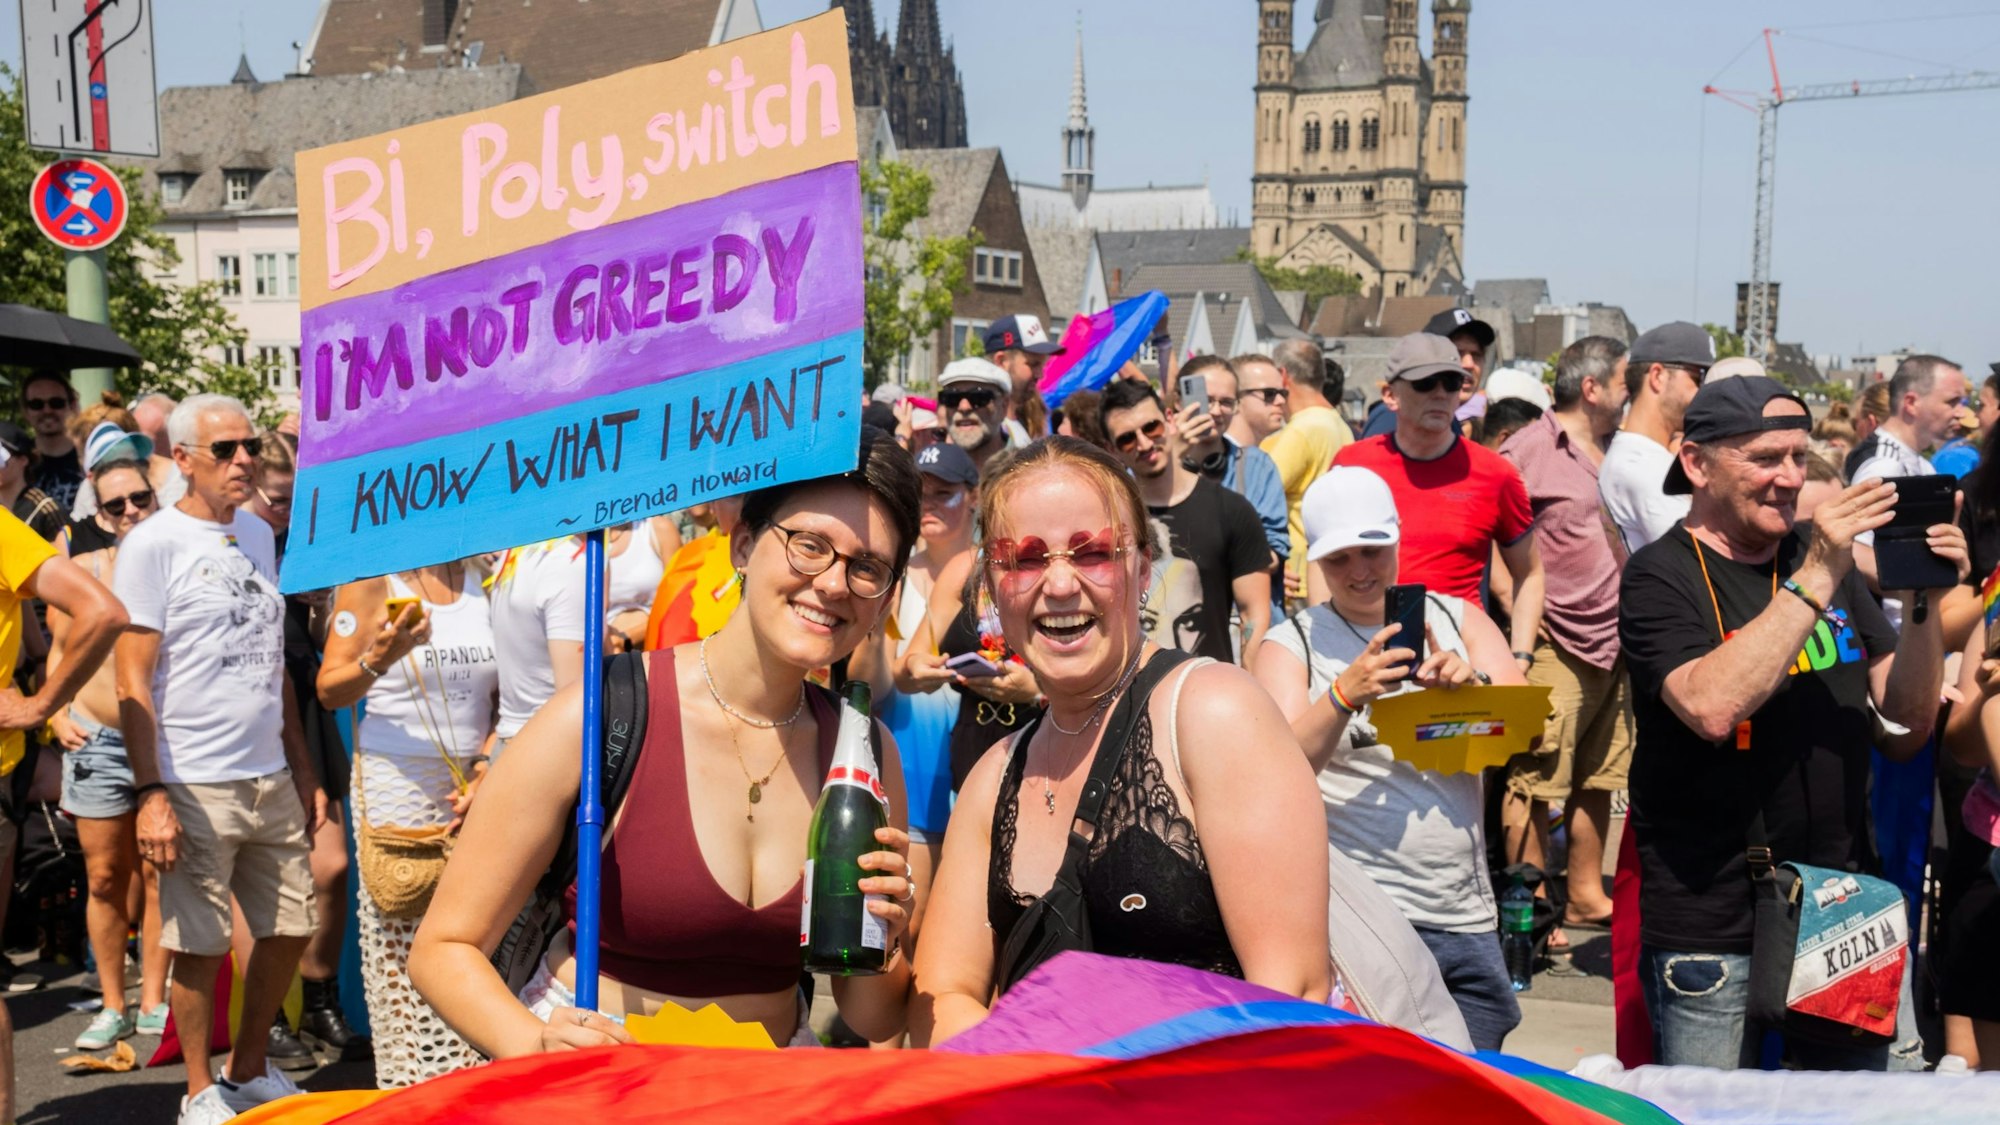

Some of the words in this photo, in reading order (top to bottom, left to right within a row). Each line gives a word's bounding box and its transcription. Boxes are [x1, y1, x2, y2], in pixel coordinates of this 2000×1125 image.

[323, 138, 434, 290] Bi,
[462, 105, 648, 237] Poly,
[643, 31, 841, 176] switch
[315, 322, 414, 421] I'M
[425, 281, 543, 382] NOT
[552, 216, 816, 345] GREEDY
[308, 487, 319, 545] I
[351, 442, 495, 533] KNOW
[506, 409, 640, 494] WHAT
[660, 403, 671, 461] I
[689, 355, 846, 450] WANT.
[595, 483, 678, 524] Brenda
[692, 458, 777, 496] Howard
[1428, 721, 1492, 738] DHL
[1823, 926, 1879, 977] KÖLN
